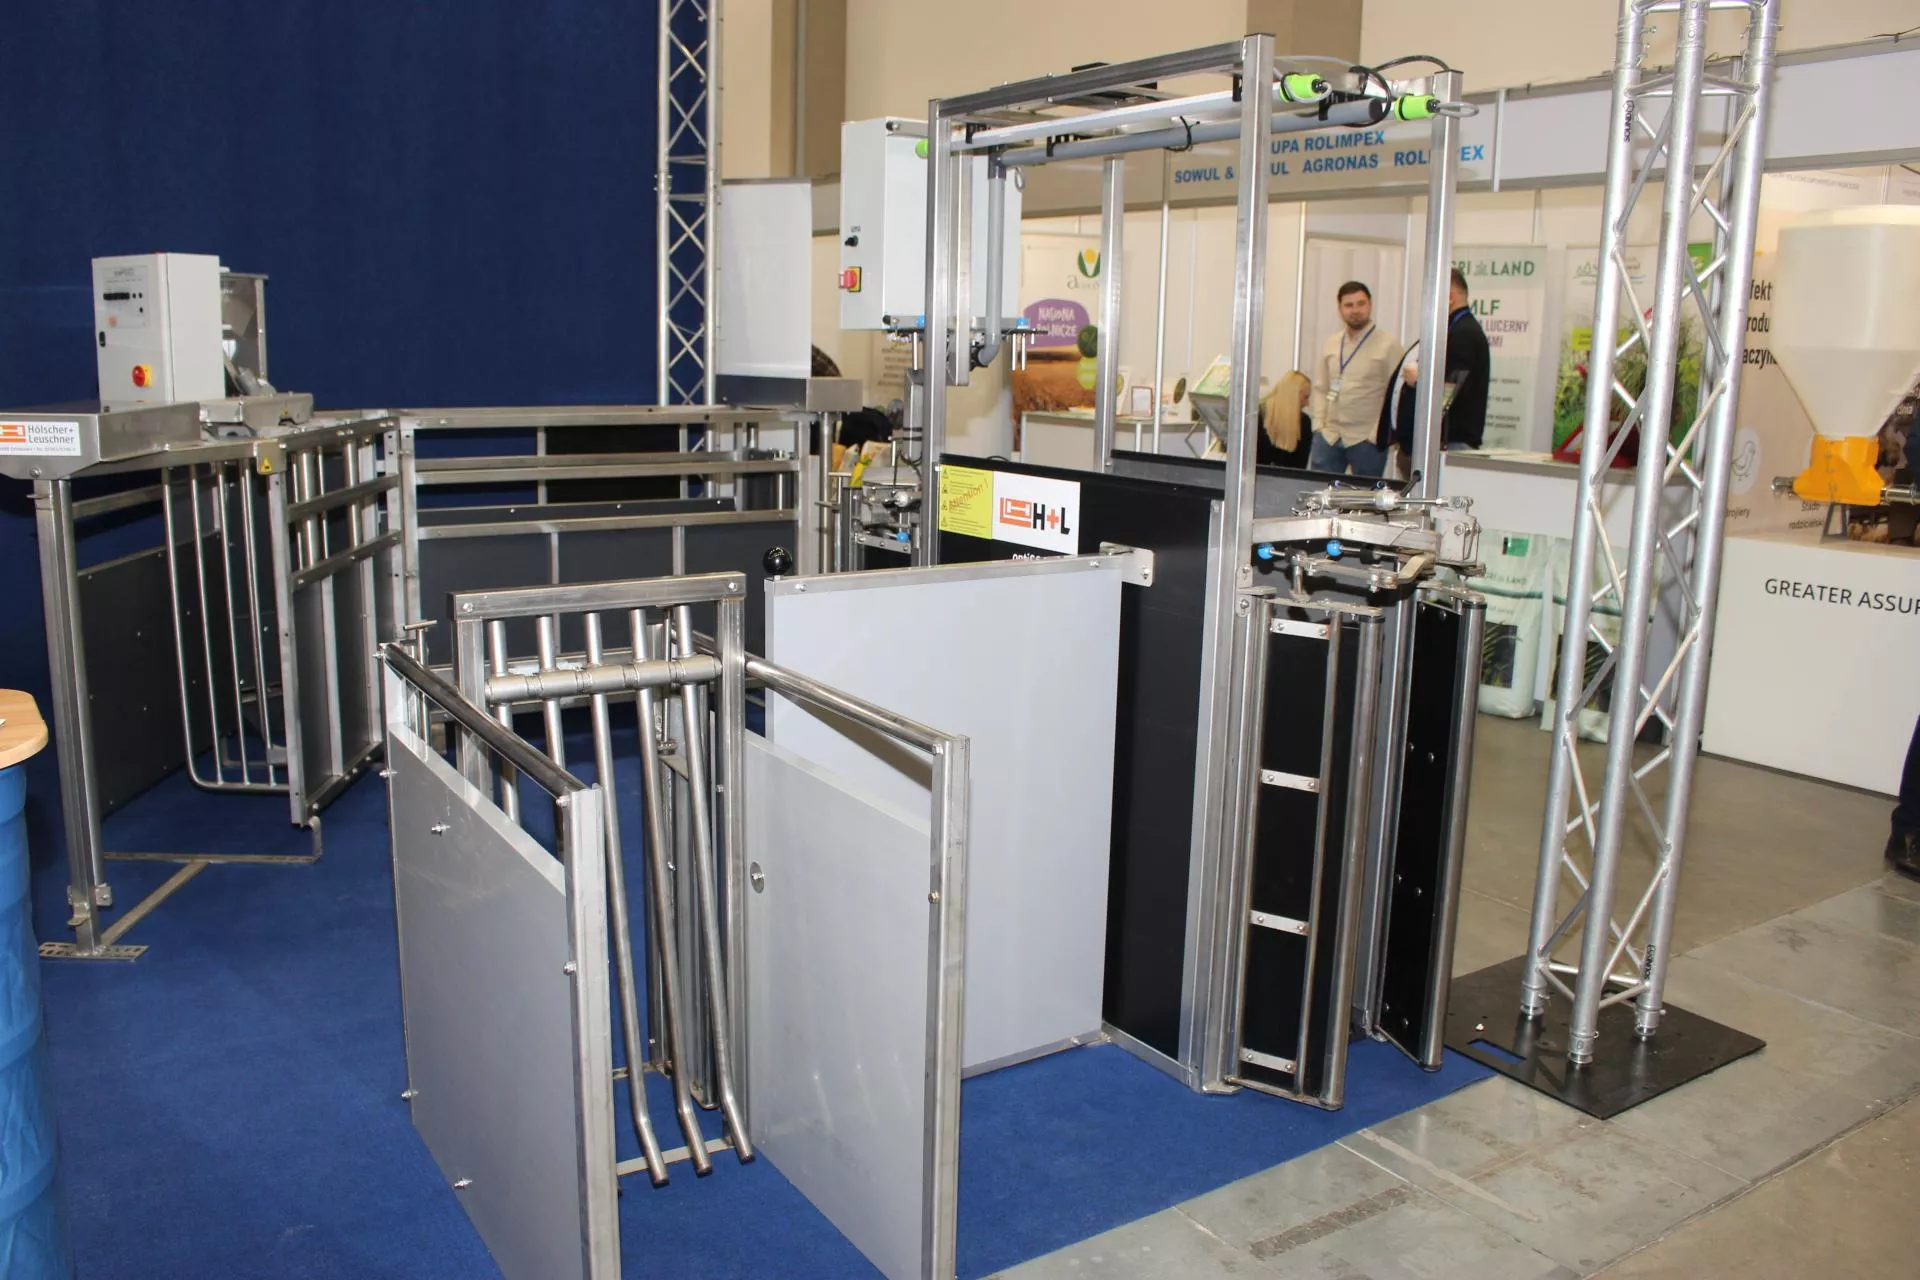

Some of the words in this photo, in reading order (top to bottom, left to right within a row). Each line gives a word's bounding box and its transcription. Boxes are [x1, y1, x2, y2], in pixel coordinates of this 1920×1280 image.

[1304, 131, 1384, 152] ROLIMPEX
[1175, 167, 1220, 183] SOWUL
[1225, 166, 1234, 179] &
[1303, 154, 1378, 174] AGRONAS
[1491, 261, 1534, 276] LAND
[1485, 318, 1528, 334] LUCERNY
[28, 435, 75, 444] Leuschner
[1765, 578, 1852, 605] GREATER
